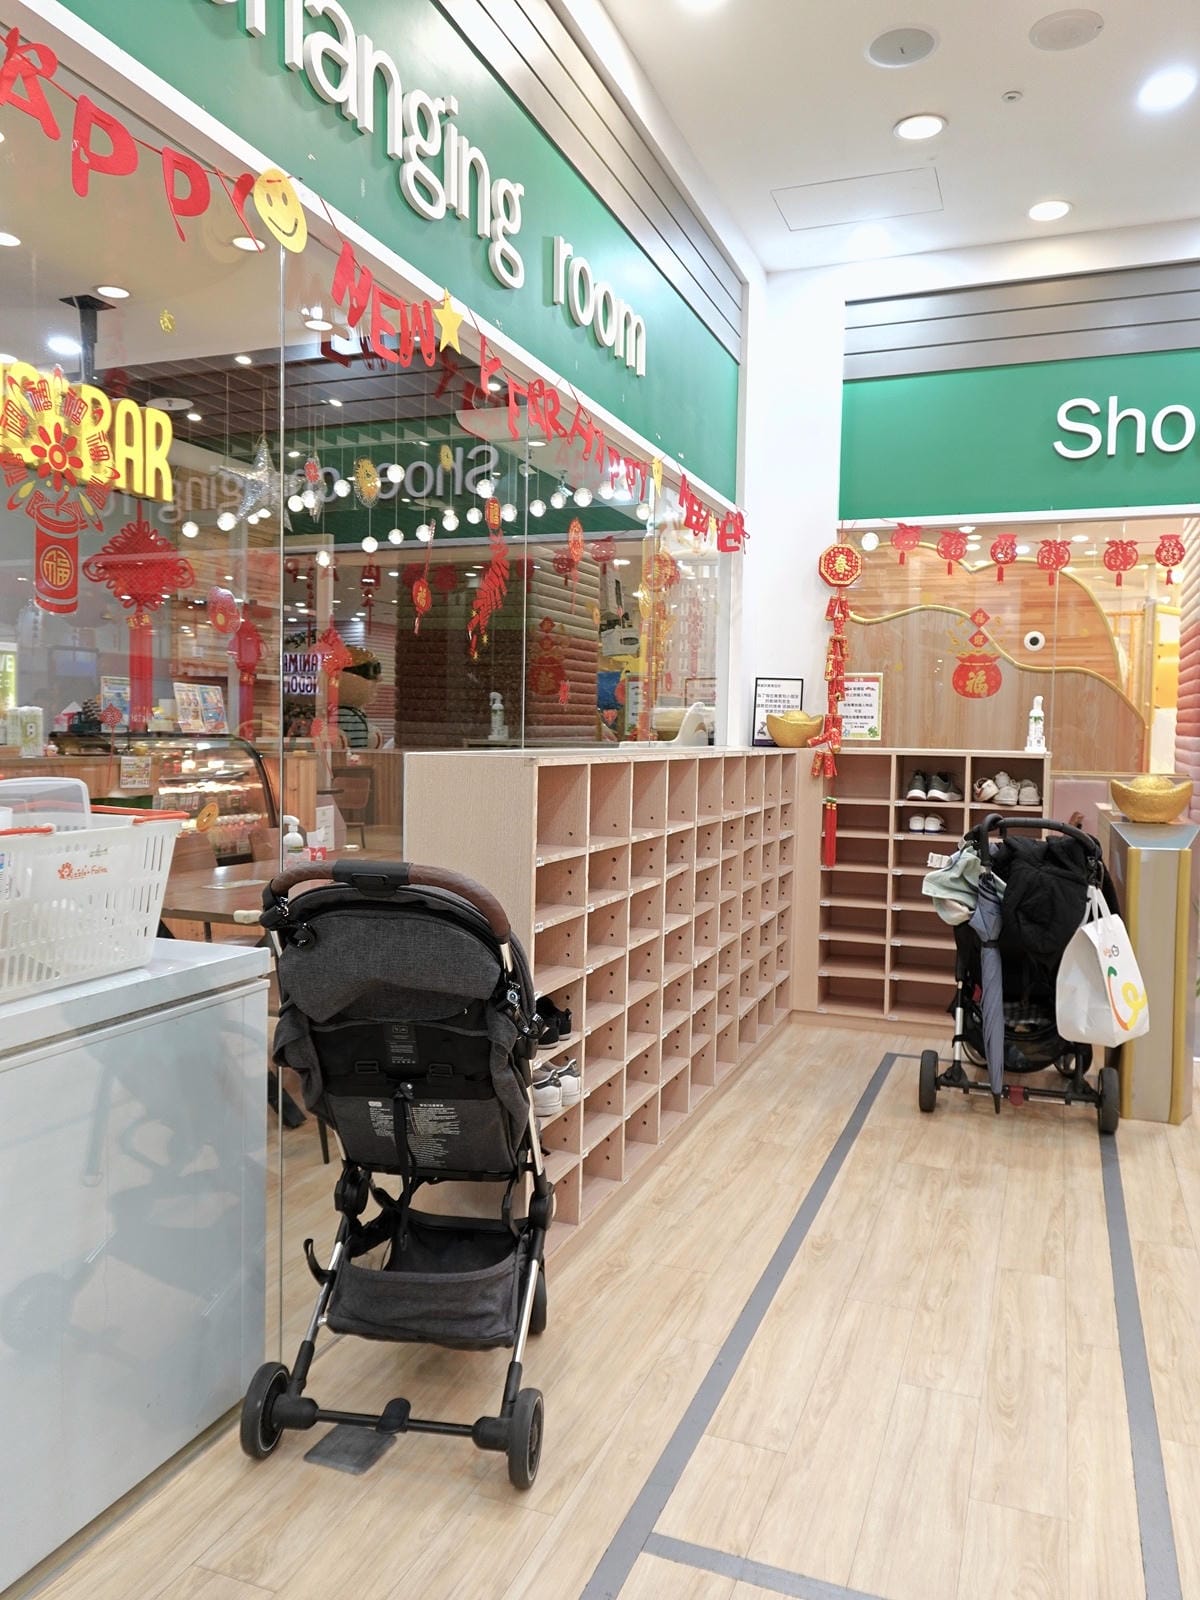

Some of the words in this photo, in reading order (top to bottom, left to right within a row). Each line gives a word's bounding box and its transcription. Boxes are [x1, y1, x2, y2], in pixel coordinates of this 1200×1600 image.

[331, 240, 437, 369] NEW
[554, 236, 646, 377] room
[80, 384, 173, 503] BAR
[1053, 396, 1197, 459] Sho
[45, 549, 73, 586] 福
[965, 669, 988, 695] 福
